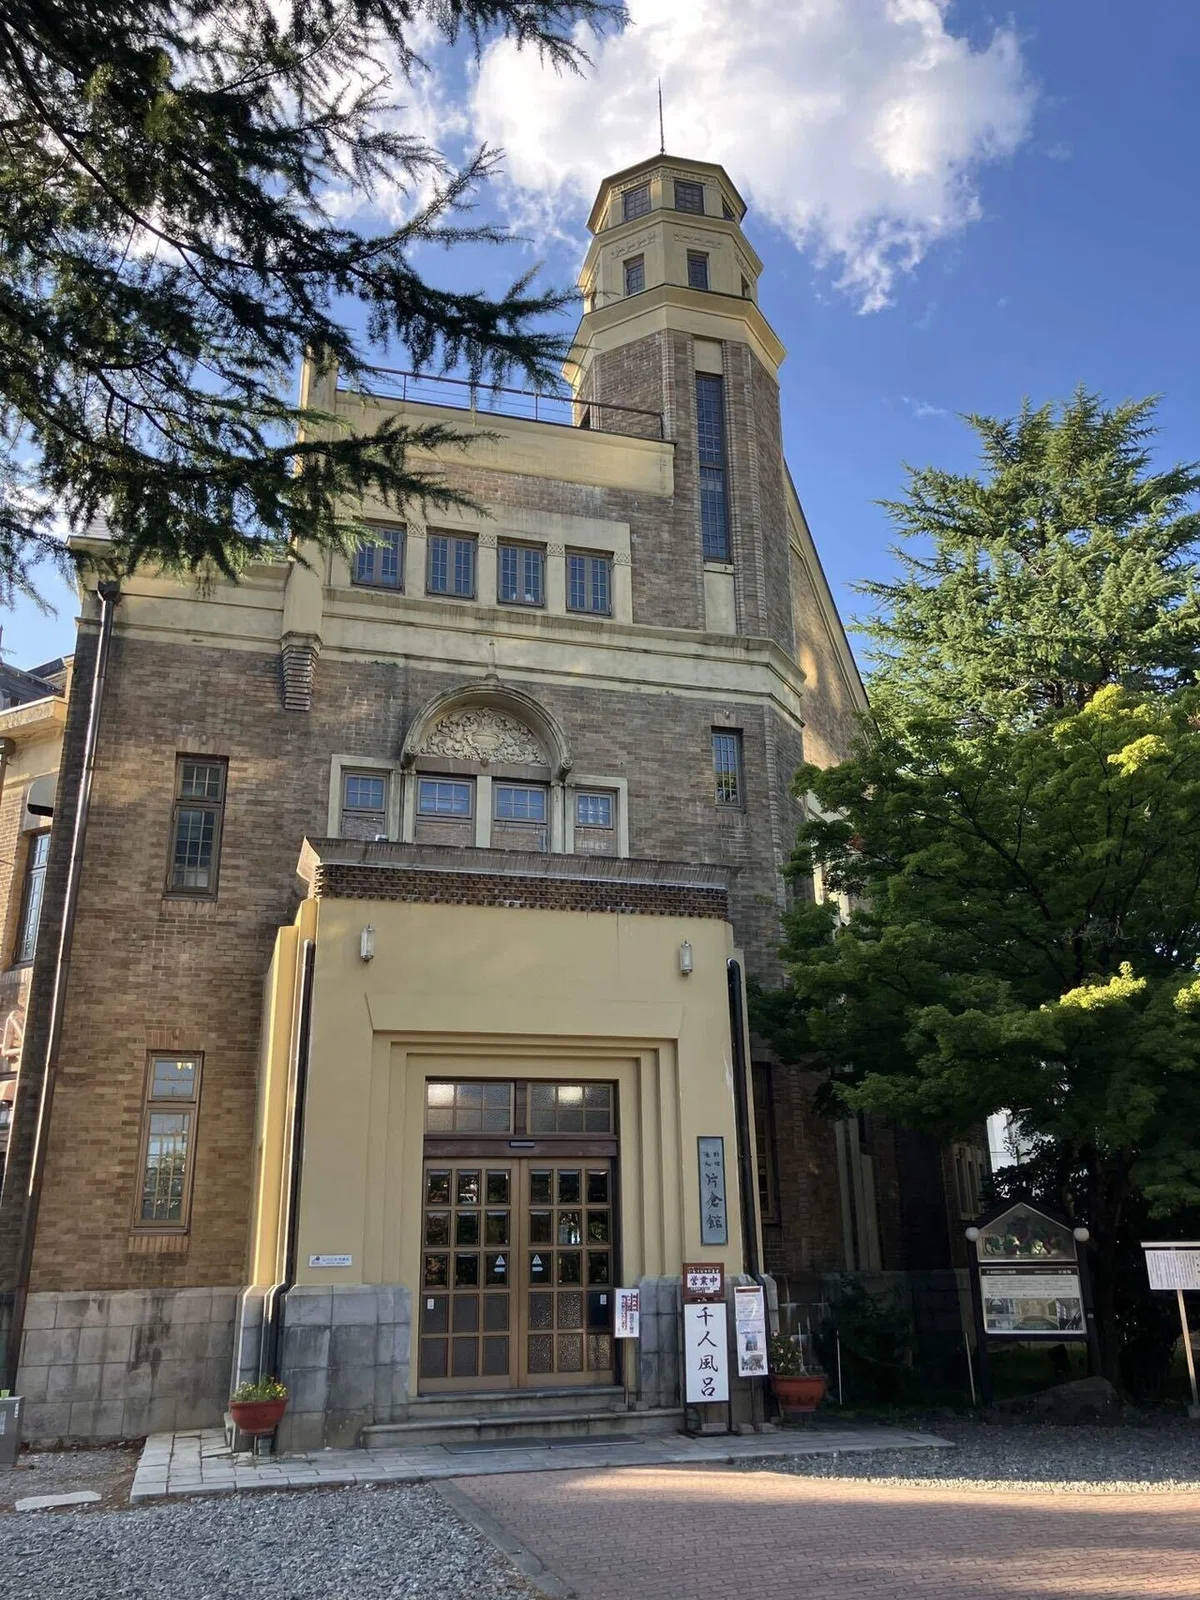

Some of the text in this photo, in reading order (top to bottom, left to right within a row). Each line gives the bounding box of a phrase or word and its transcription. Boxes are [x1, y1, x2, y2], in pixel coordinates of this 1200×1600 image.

[690, 1275, 718, 1286] 営業中
[696, 1306, 719, 1397] 千人風呂
